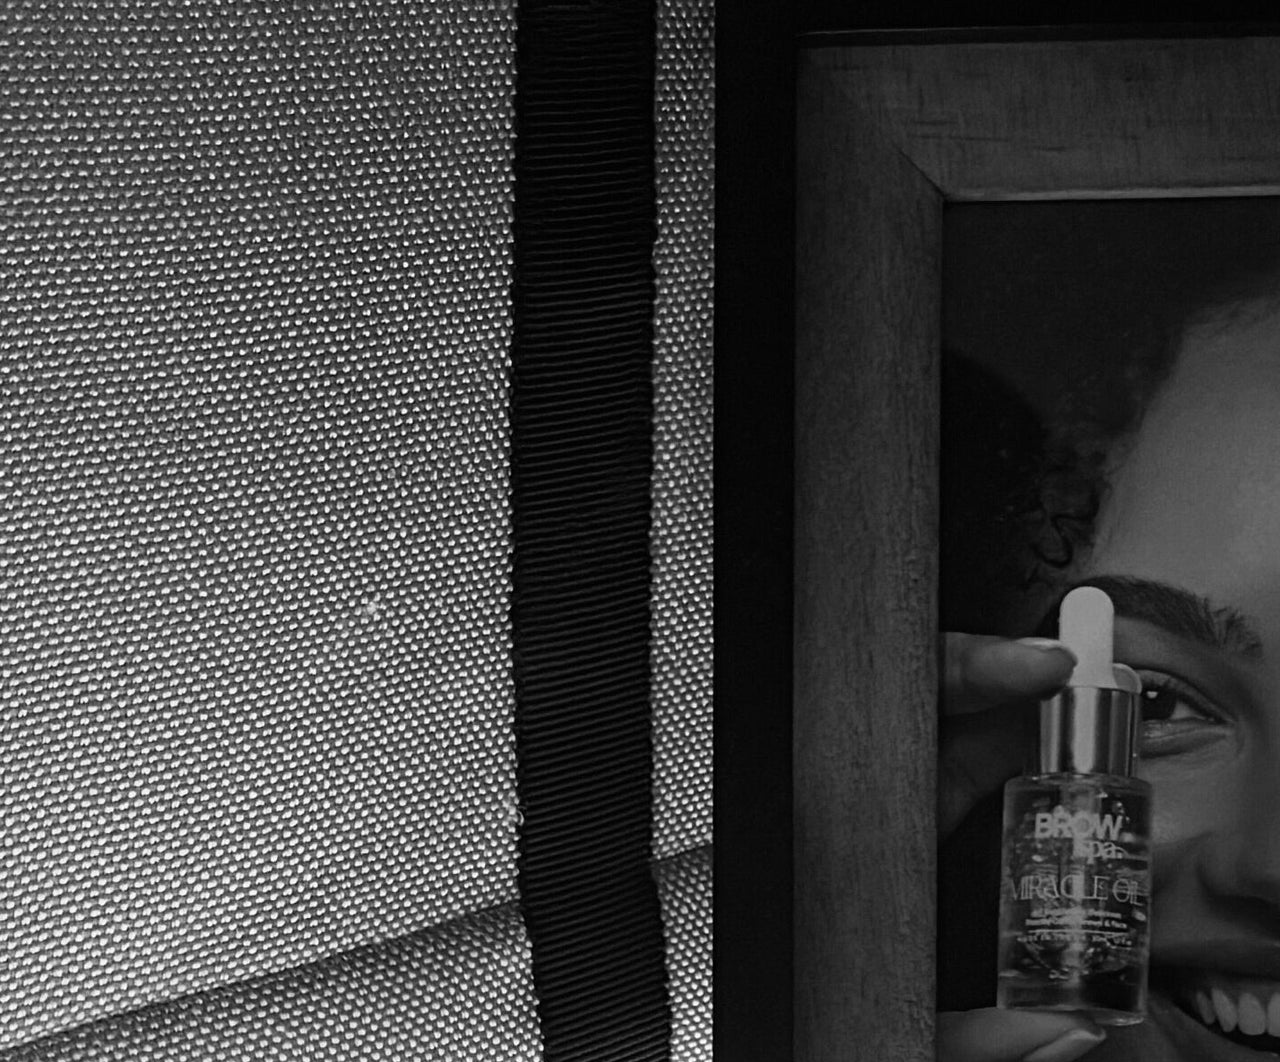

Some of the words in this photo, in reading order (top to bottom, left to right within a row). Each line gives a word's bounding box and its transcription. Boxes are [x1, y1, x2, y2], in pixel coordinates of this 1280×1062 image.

[1035, 812, 1123, 841] BROW
[1007, 874, 1110, 900] MIRACLE
[1112, 878, 1144, 906] OIL
